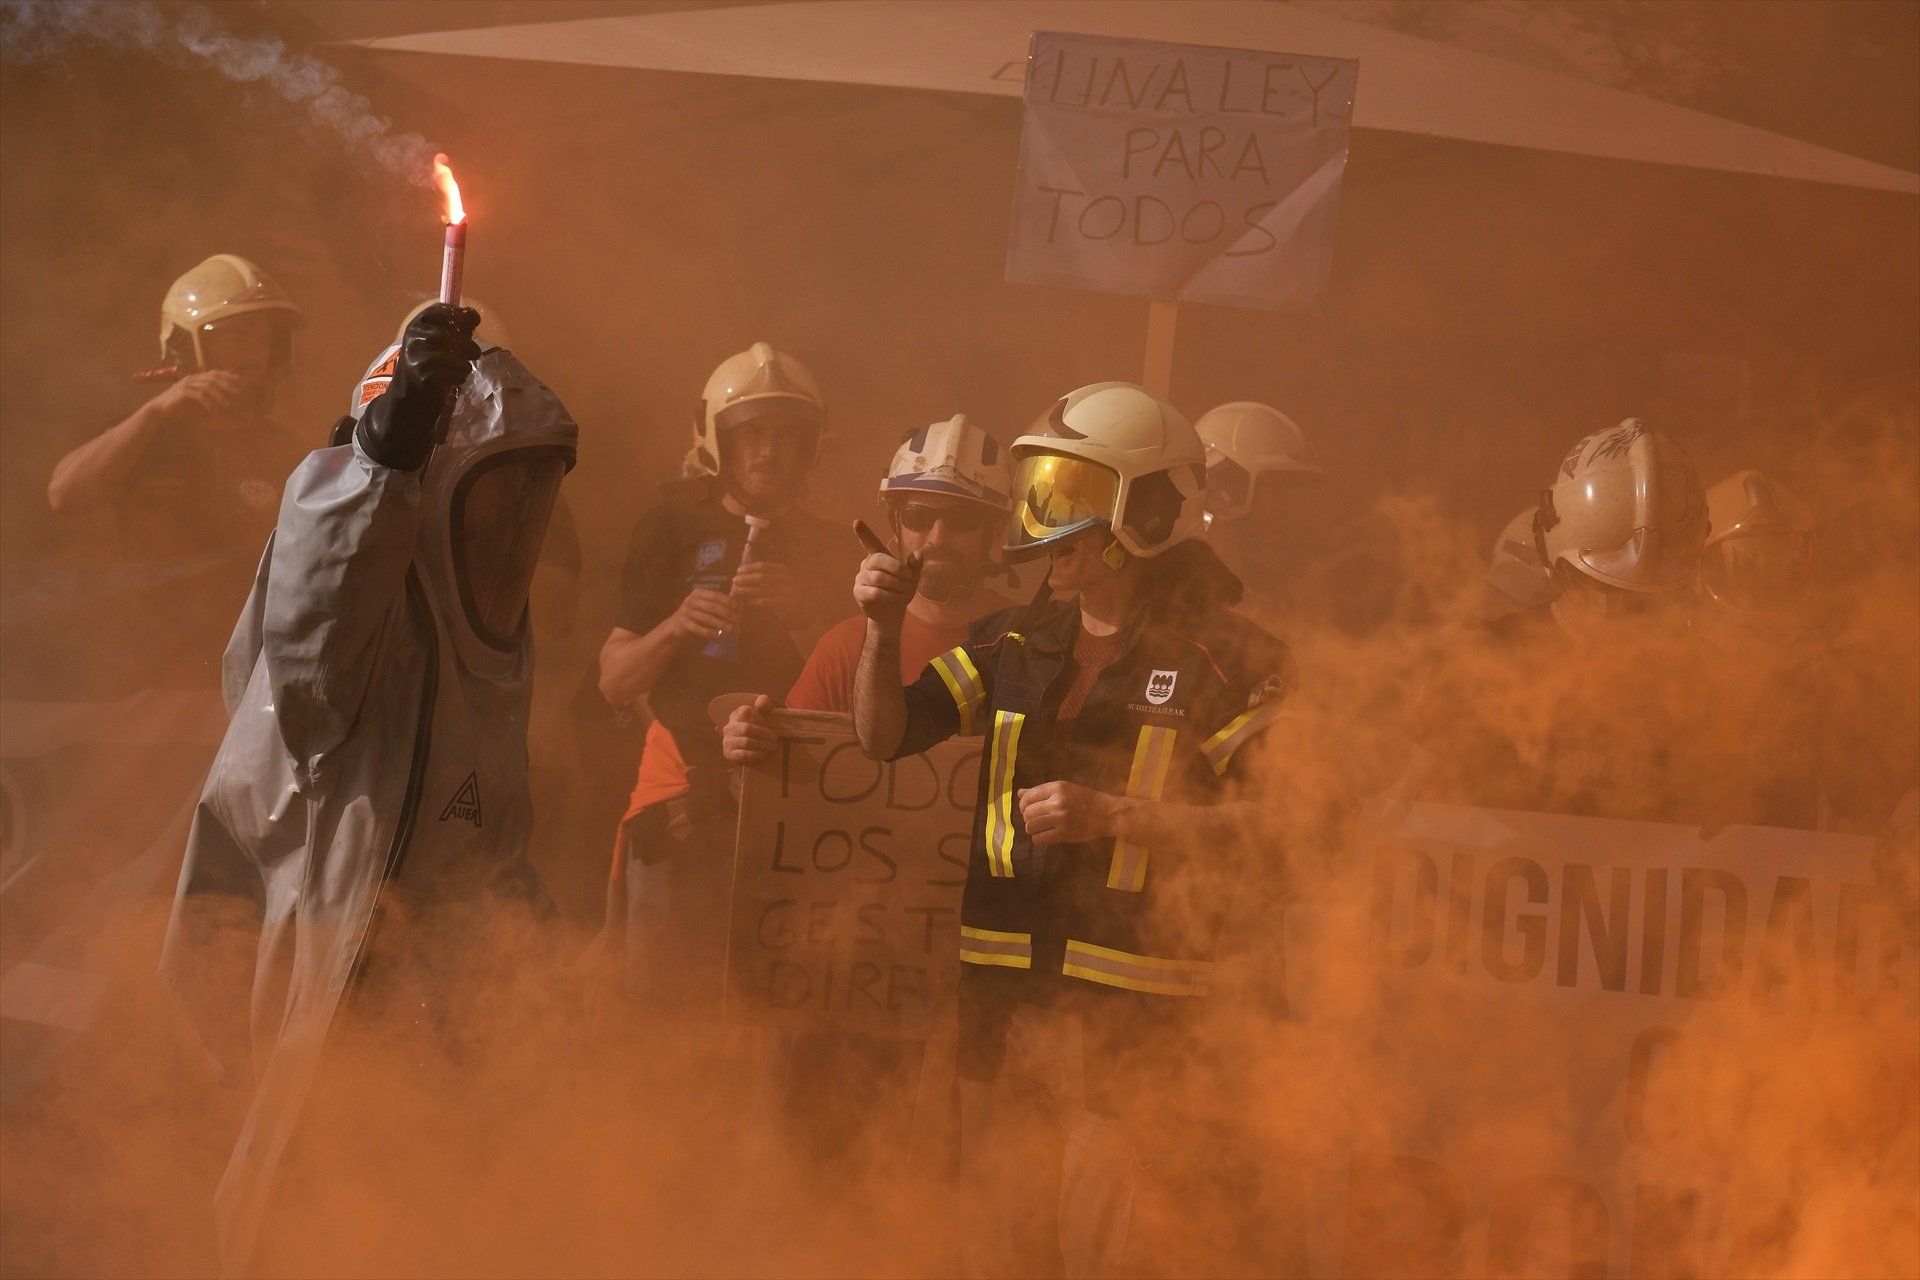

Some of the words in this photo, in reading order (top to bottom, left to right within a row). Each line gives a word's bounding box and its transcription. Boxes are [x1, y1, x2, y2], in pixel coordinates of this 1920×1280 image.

[1218, 60, 1340, 128] LEY
[1122, 126, 1270, 187] PARA
[1038, 185, 1277, 258] TODOS
[770, 820, 898, 885] LOS
